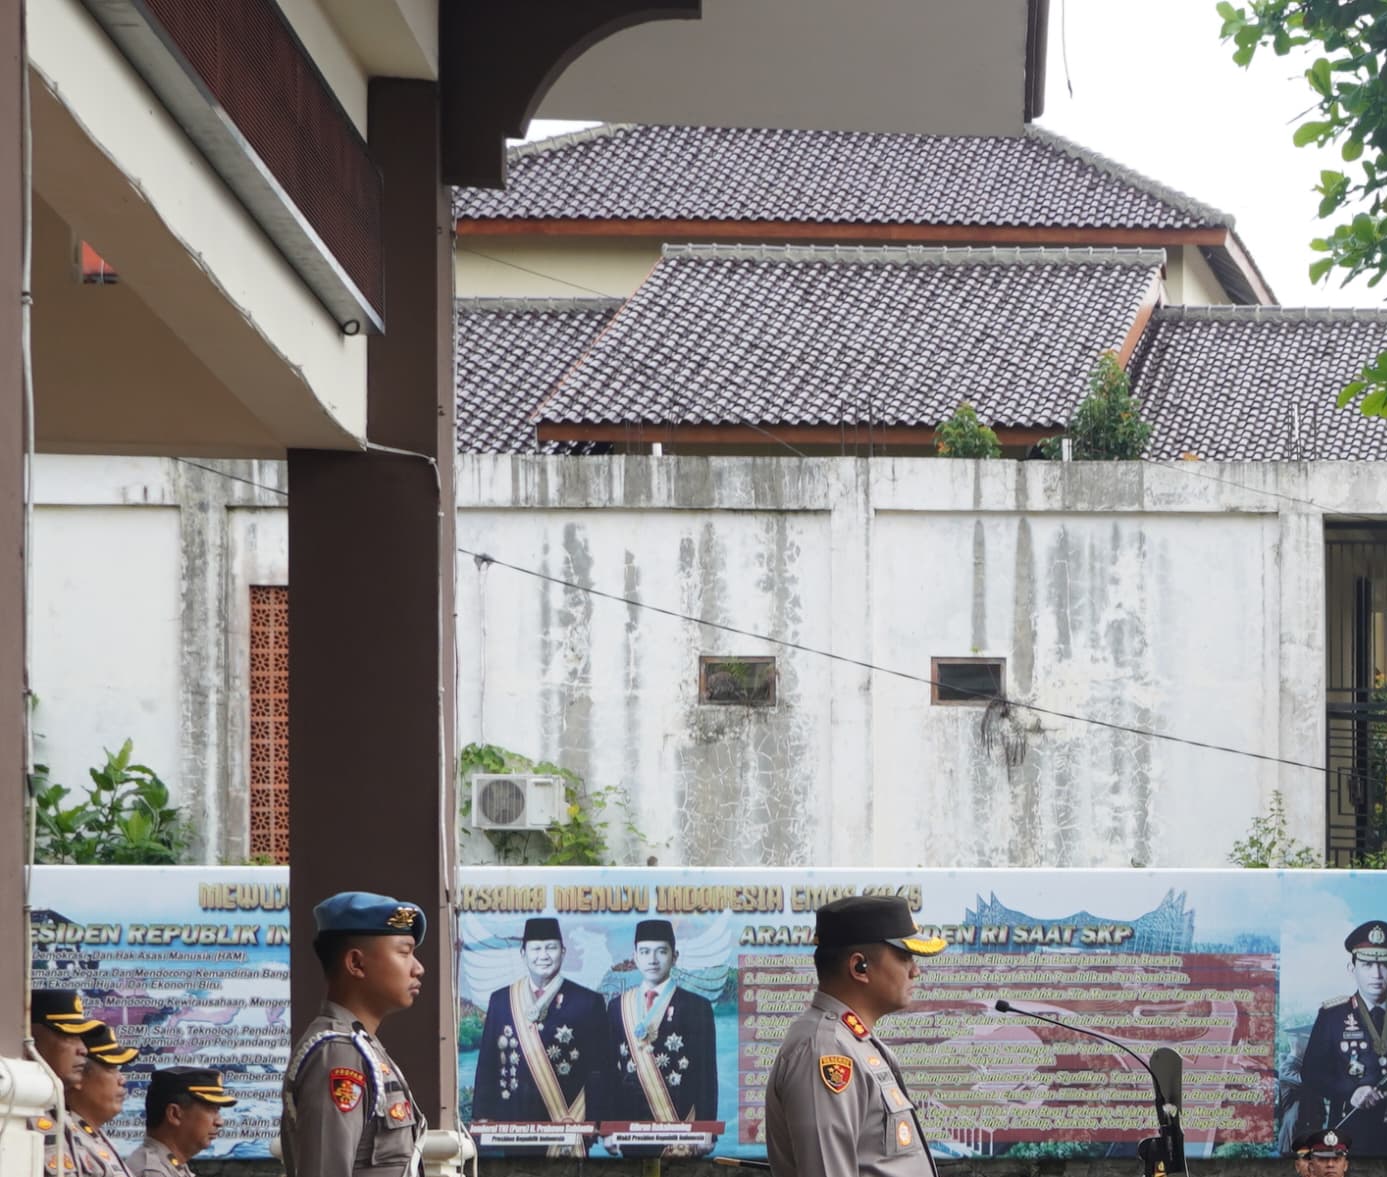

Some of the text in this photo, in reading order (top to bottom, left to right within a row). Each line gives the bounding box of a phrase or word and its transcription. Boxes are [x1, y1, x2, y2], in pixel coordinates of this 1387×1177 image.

[199, 883, 290, 911] MEWUJ
[462, 885, 546, 913] RSAMA
[31, 923, 122, 945] ESIDEN
[127, 923, 260, 945] REPUBLIK
[981, 925, 1008, 945] RI
[1014, 925, 1076, 945] SAAT
[1083, 925, 1133, 945] SKP
